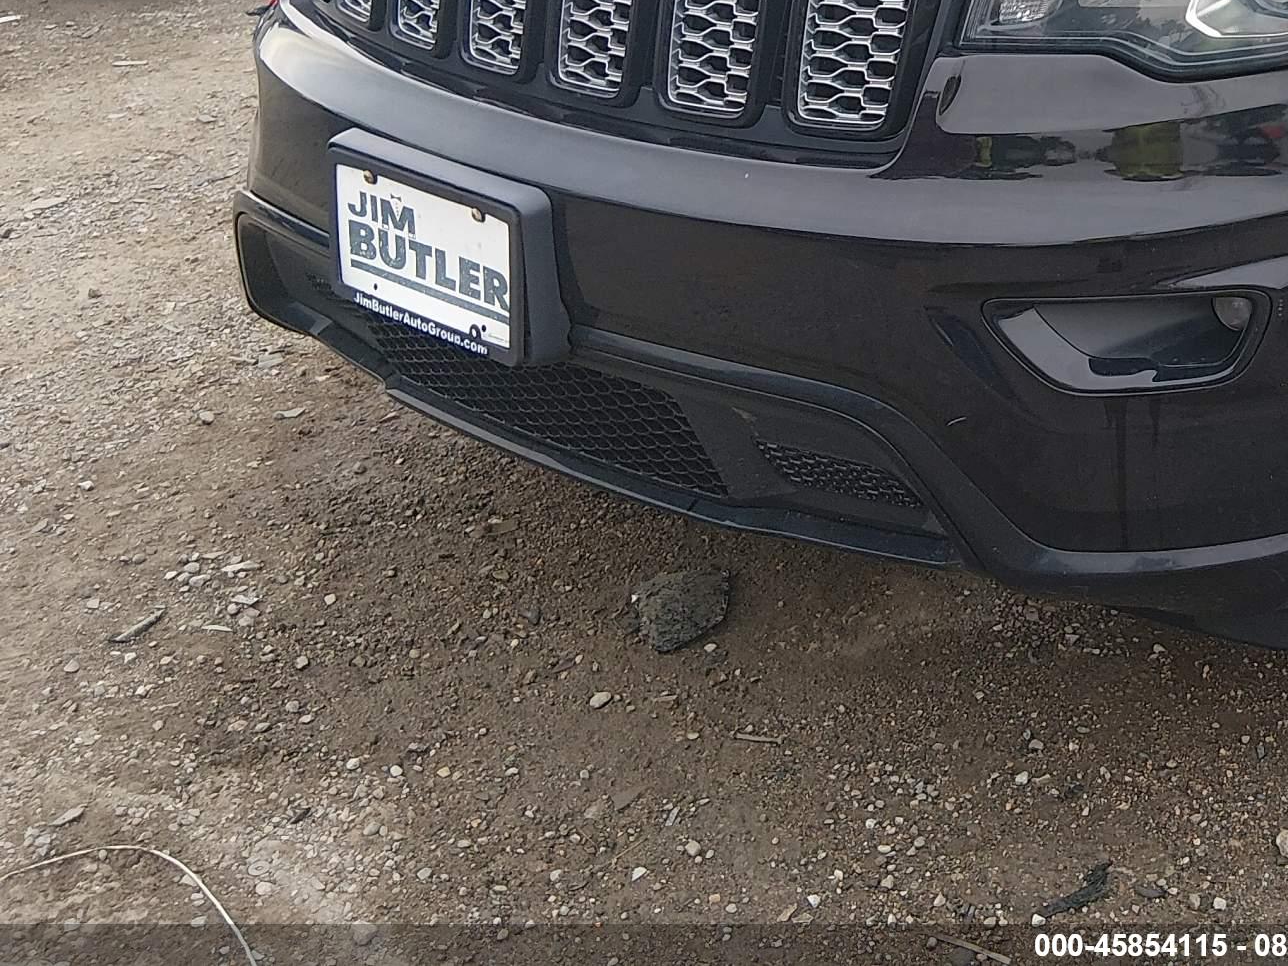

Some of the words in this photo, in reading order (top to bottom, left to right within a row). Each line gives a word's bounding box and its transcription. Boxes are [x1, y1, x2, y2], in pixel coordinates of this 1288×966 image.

[348, 191, 416, 235] JIM
[348, 219, 509, 310] BUTLER
[353, 293, 488, 355] JimButlerAutoGroup.com
